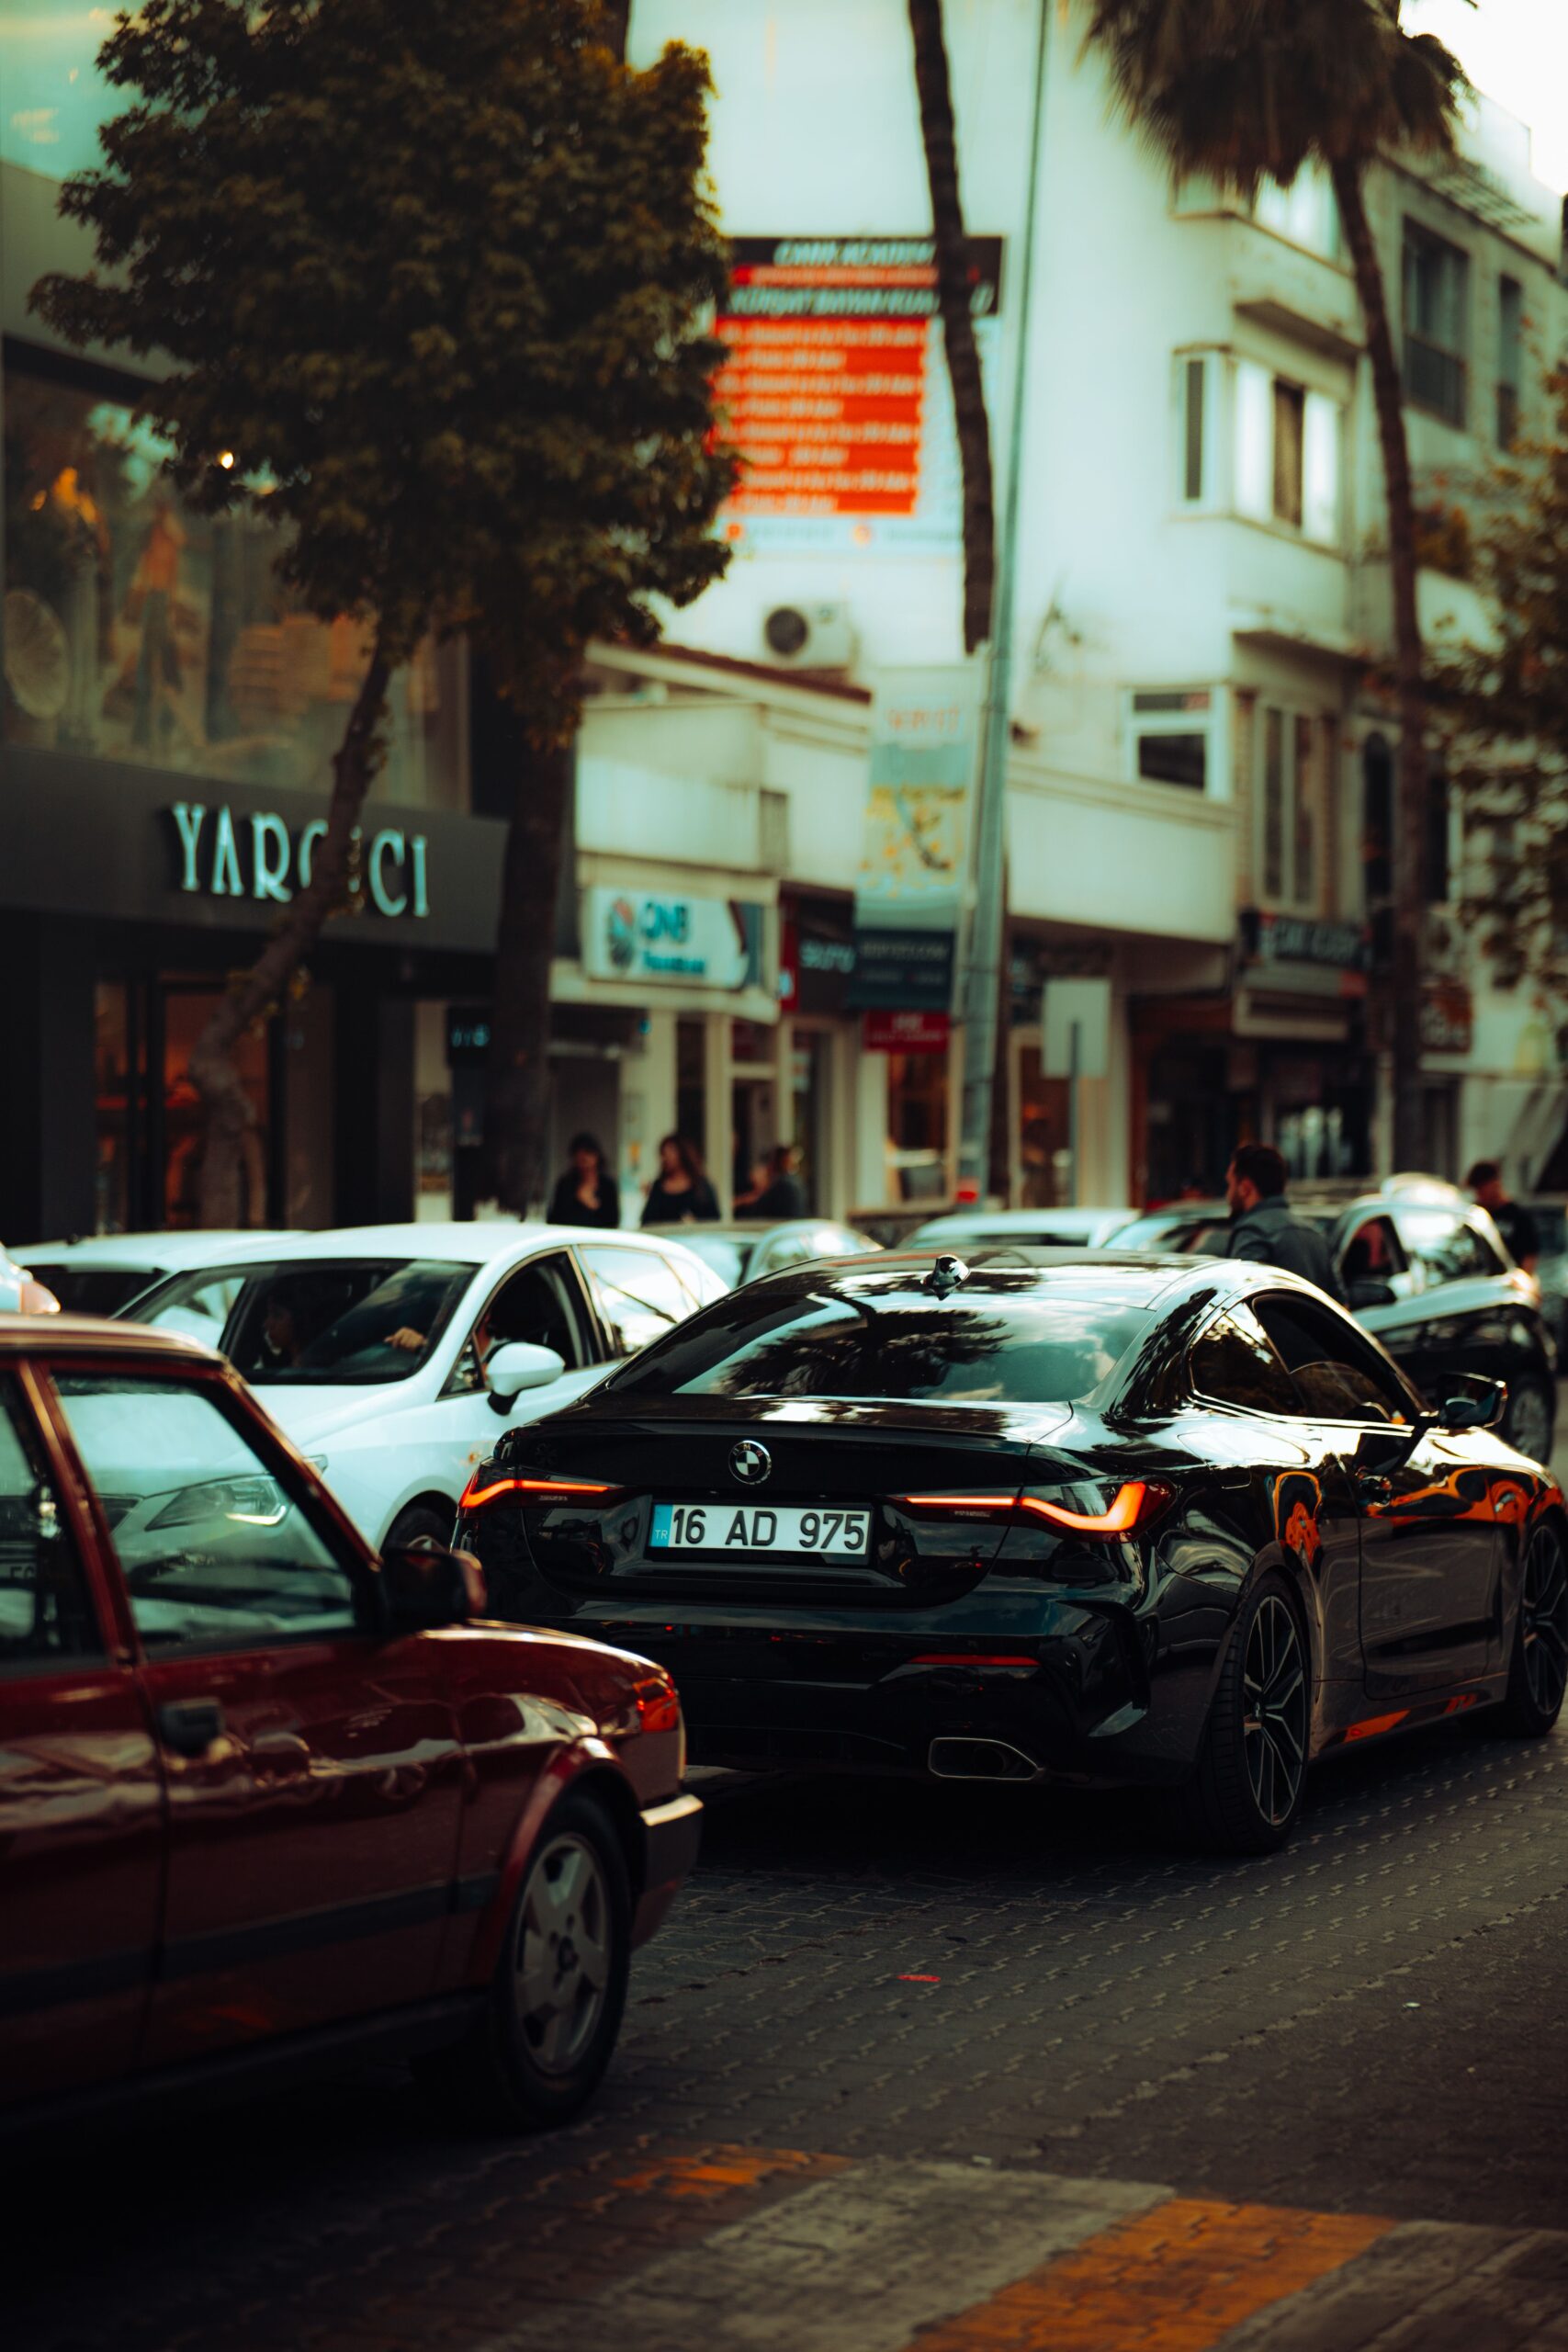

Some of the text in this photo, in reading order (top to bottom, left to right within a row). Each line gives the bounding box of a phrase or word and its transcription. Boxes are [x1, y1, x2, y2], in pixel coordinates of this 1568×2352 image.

[172, 801, 430, 919] YARCI
[654, 1529, 669, 1540] TR
[673, 1508, 865, 1551] 16 AD 975
